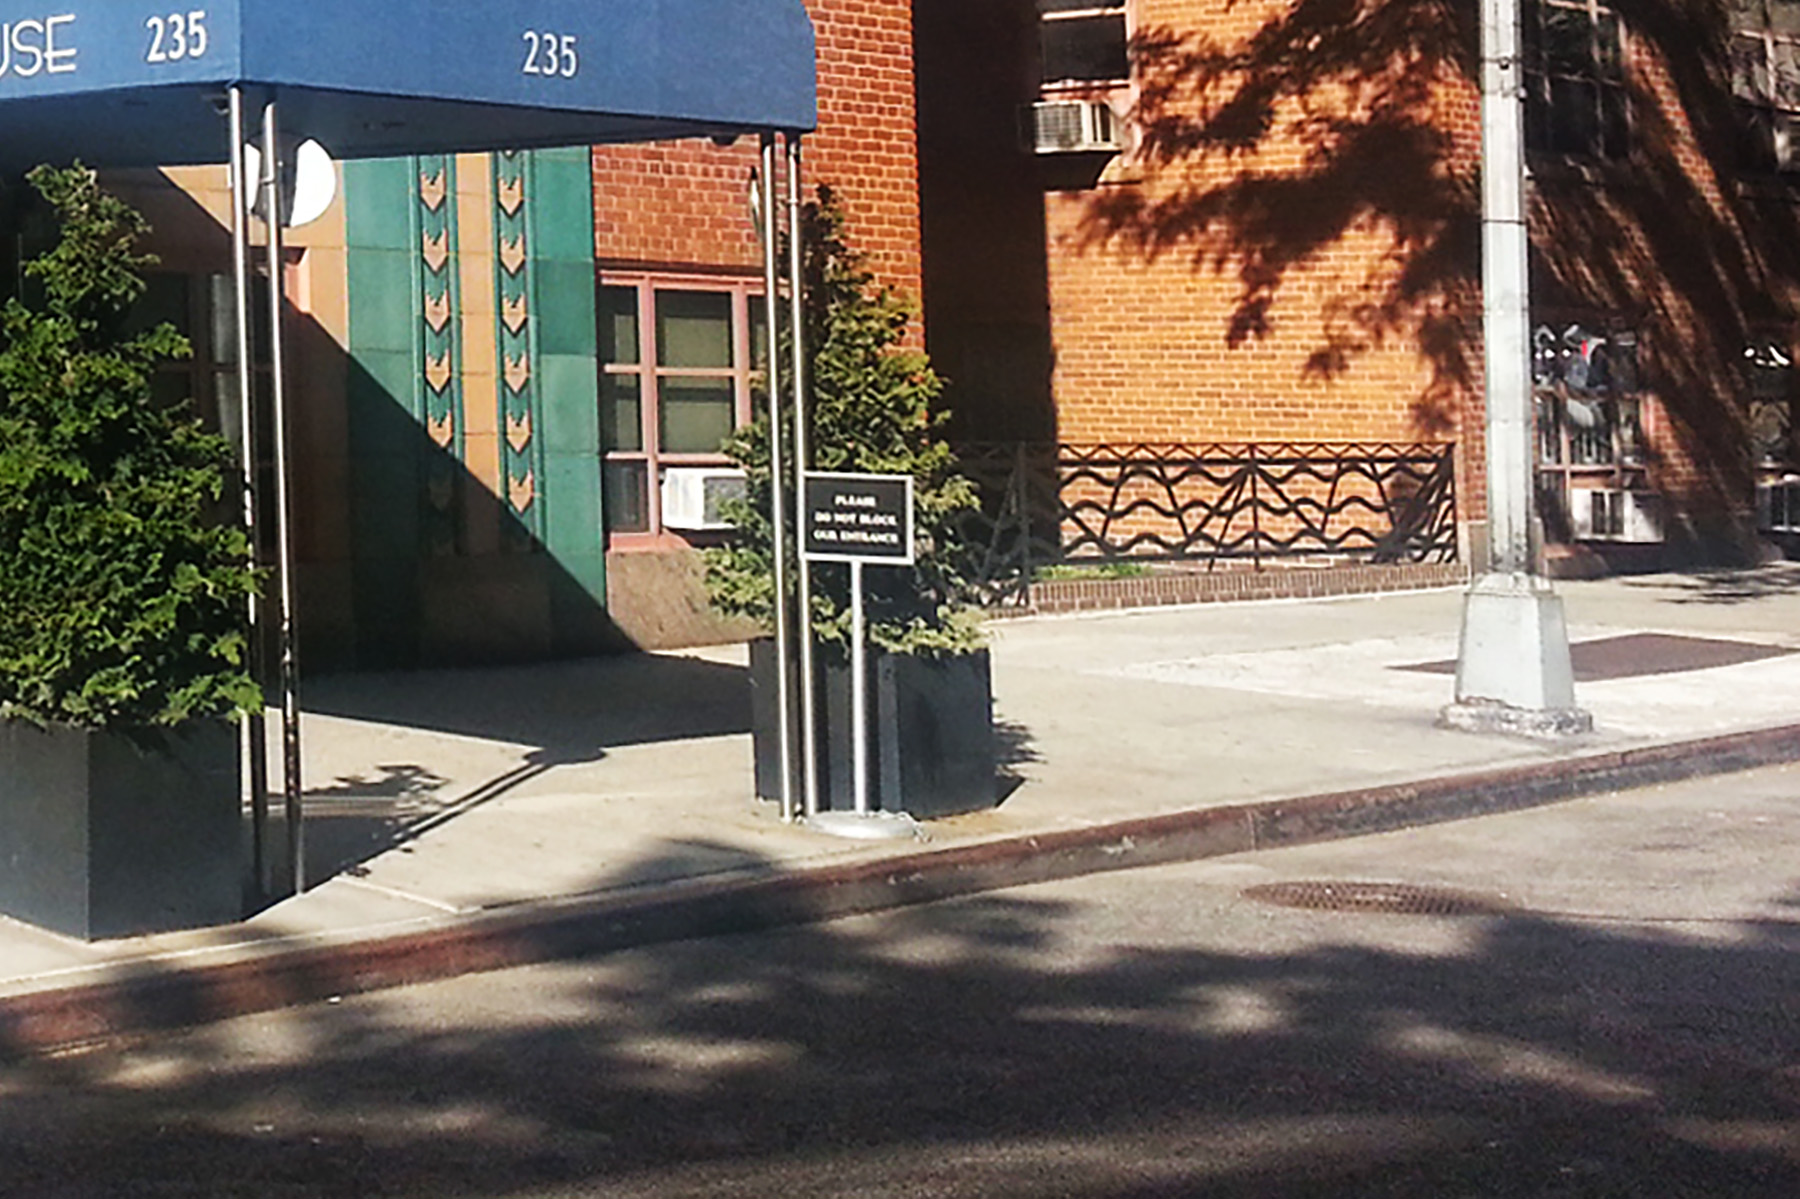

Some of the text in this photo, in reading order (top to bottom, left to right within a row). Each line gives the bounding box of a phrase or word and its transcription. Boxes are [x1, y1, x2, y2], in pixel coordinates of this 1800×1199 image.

[145, 10, 208, 64] 235
[521, 29, 578, 78] 235
[835, 495, 876, 507] PLEASE
[814, 511, 898, 526] DO NOT BLOCK
[813, 529, 899, 544] OUR ENTRANCE
